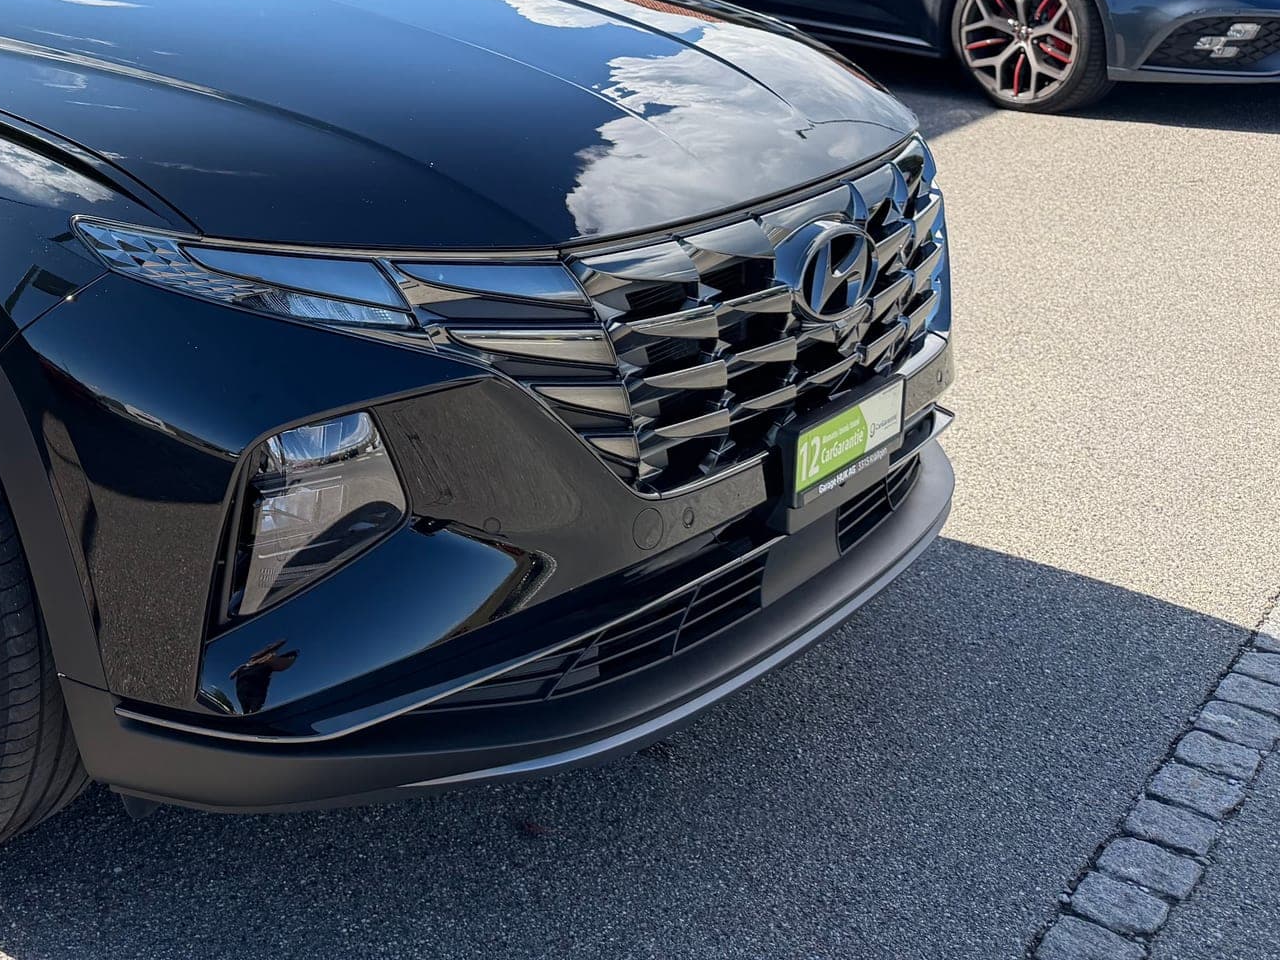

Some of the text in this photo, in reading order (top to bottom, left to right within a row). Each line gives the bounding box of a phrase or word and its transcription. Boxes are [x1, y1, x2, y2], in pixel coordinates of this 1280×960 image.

[799, 436, 819, 481] 12
[821, 427, 864, 464] CarGarantie
[818, 479, 836, 494] Garage
[836, 469, 849, 483] HUK
